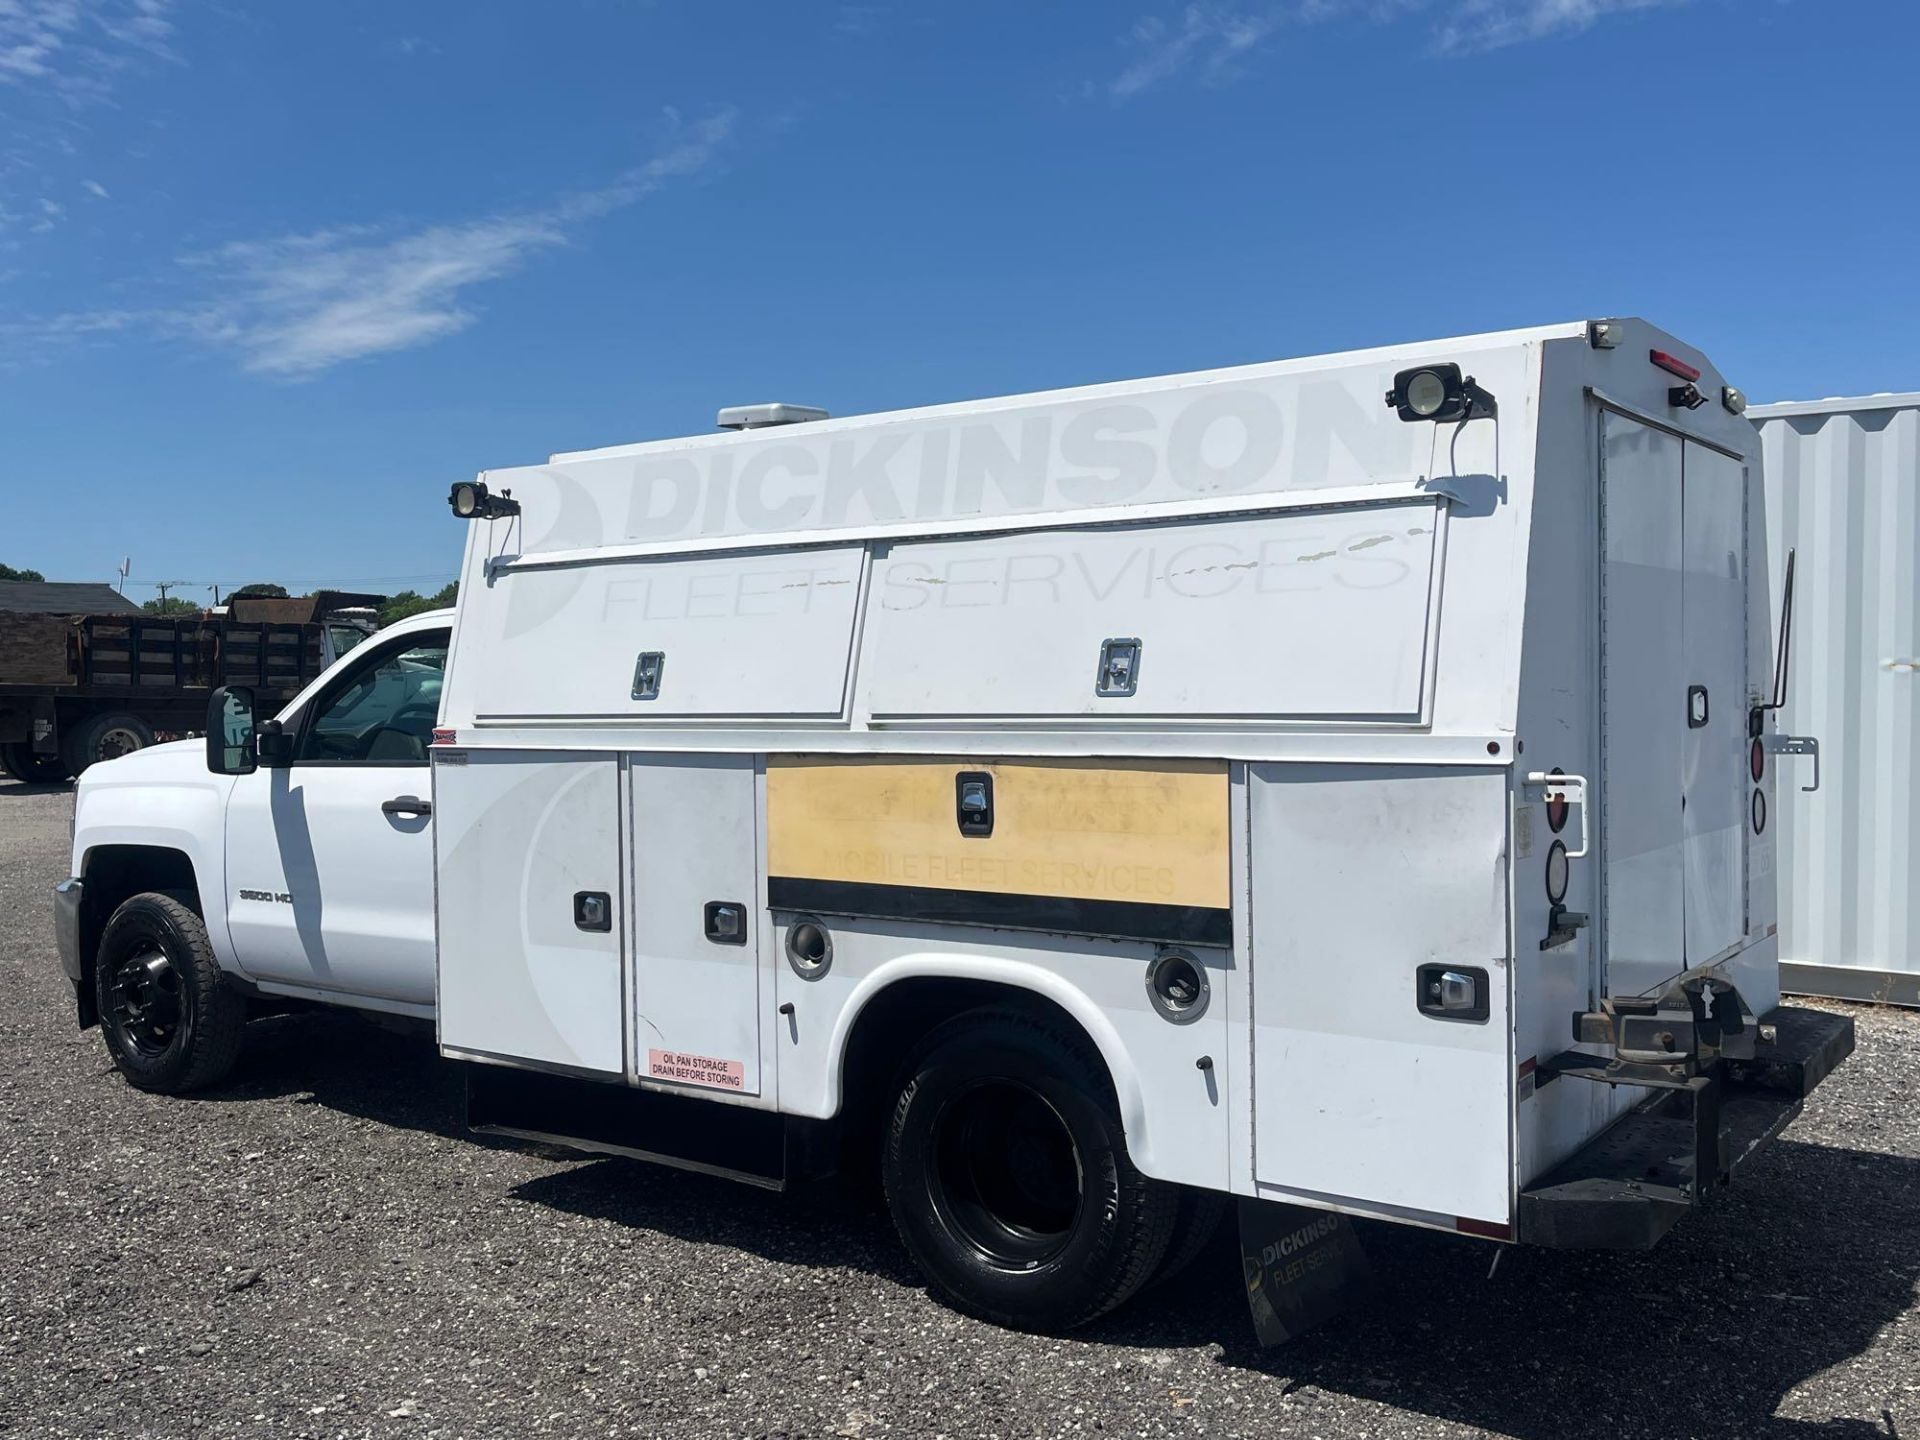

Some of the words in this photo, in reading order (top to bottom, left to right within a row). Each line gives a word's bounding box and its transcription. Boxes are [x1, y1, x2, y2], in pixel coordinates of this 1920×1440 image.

[624, 374, 1415, 540] DICKINSON
[602, 567, 839, 623] FLEET
[881, 530, 1414, 611] SERVICES
[823, 849, 919, 880] MOBILE
[930, 855, 1014, 887] FLEET
[1023, 862, 1176, 897] SERVICES
[652, 1064, 675, 1076] DRAIN
[677, 1068, 706, 1081] BEFORE
[707, 1072, 740, 1086] STORING
[663, 1054, 675, 1065] OIL
[677, 1055, 691, 1067] PAN
[692, 1058, 728, 1072] STORAGE
[1262, 1213, 1346, 1266] DICKINSO
[1273, 1257, 1307, 1288] FLEET
